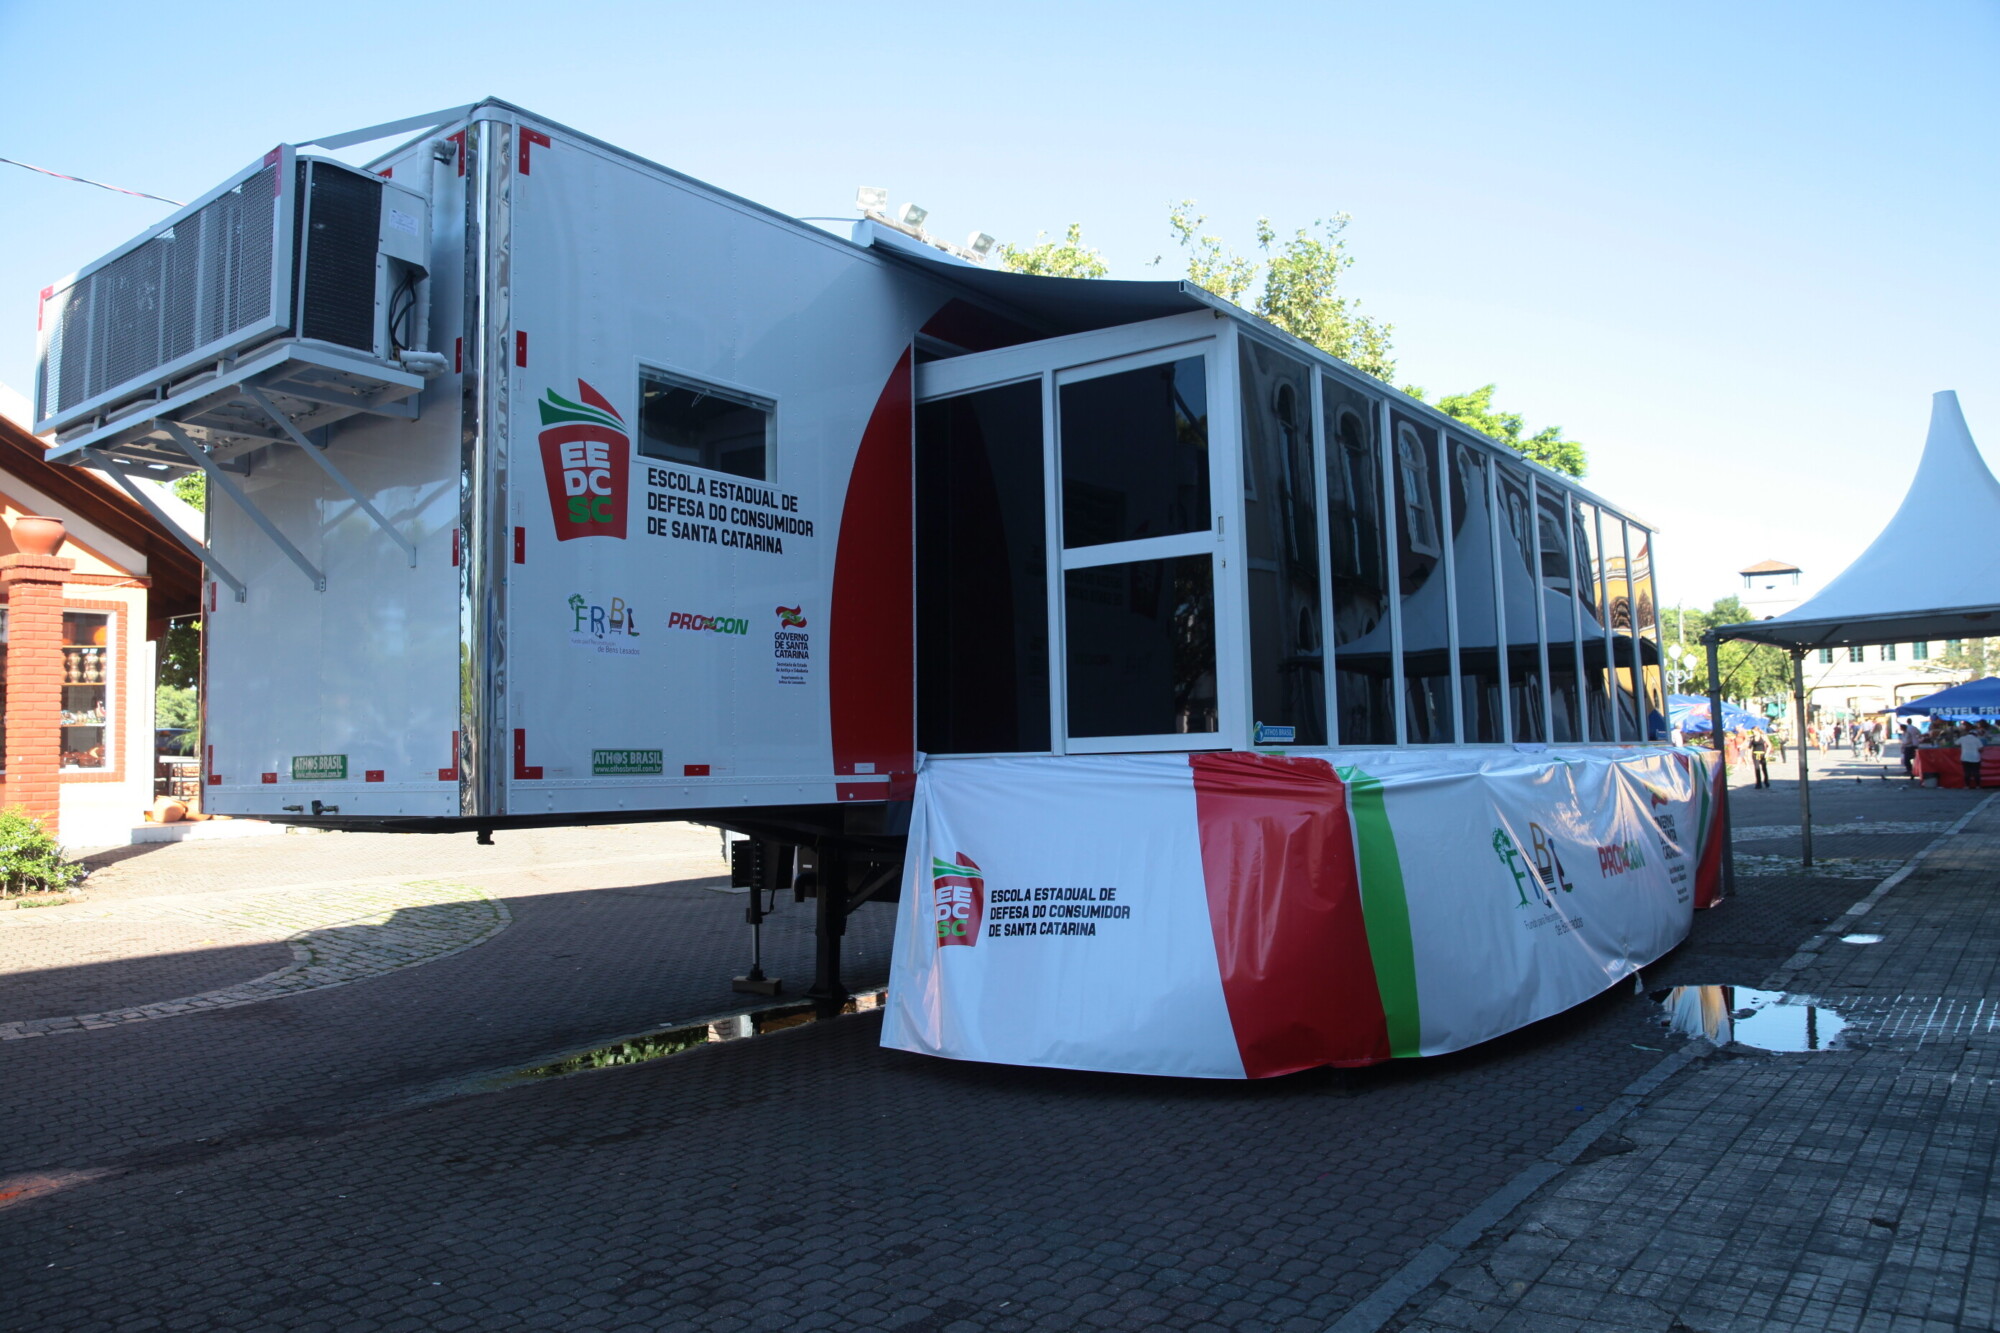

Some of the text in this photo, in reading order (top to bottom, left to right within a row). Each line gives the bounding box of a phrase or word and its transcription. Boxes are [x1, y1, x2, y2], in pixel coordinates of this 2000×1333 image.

[559, 440, 610, 470] EE
[563, 468, 612, 496] DC
[647, 467, 798, 513] ESCOLA ESTADUAL DE
[567, 496, 613, 523] SC
[647, 491, 814, 538] DEFESA DO CONSUMIDOR
[647, 516, 783, 555] DE SANTA CATARINA
[668, 611, 749, 636] PROCON
[774, 632, 809, 641] GOVERNO
[774, 640, 808, 650] DE SANTA
[774, 649, 809, 660] CATARINA
[1930, 707, 1976, 716] PASTEL
[319, 755, 343, 769] BRASIL
[630, 751, 662, 765] BRASIL
[936, 885, 973, 905] EE
[991, 887, 1117, 904] ESCOLA ESTADUAL DE
[936, 902, 970, 921] DC
[989, 904, 1131, 920] DEFESA DO CONSUMIDOR
[937, 919, 968, 938] SC
[988, 921, 1097, 938] DE SANTA CATARINA
